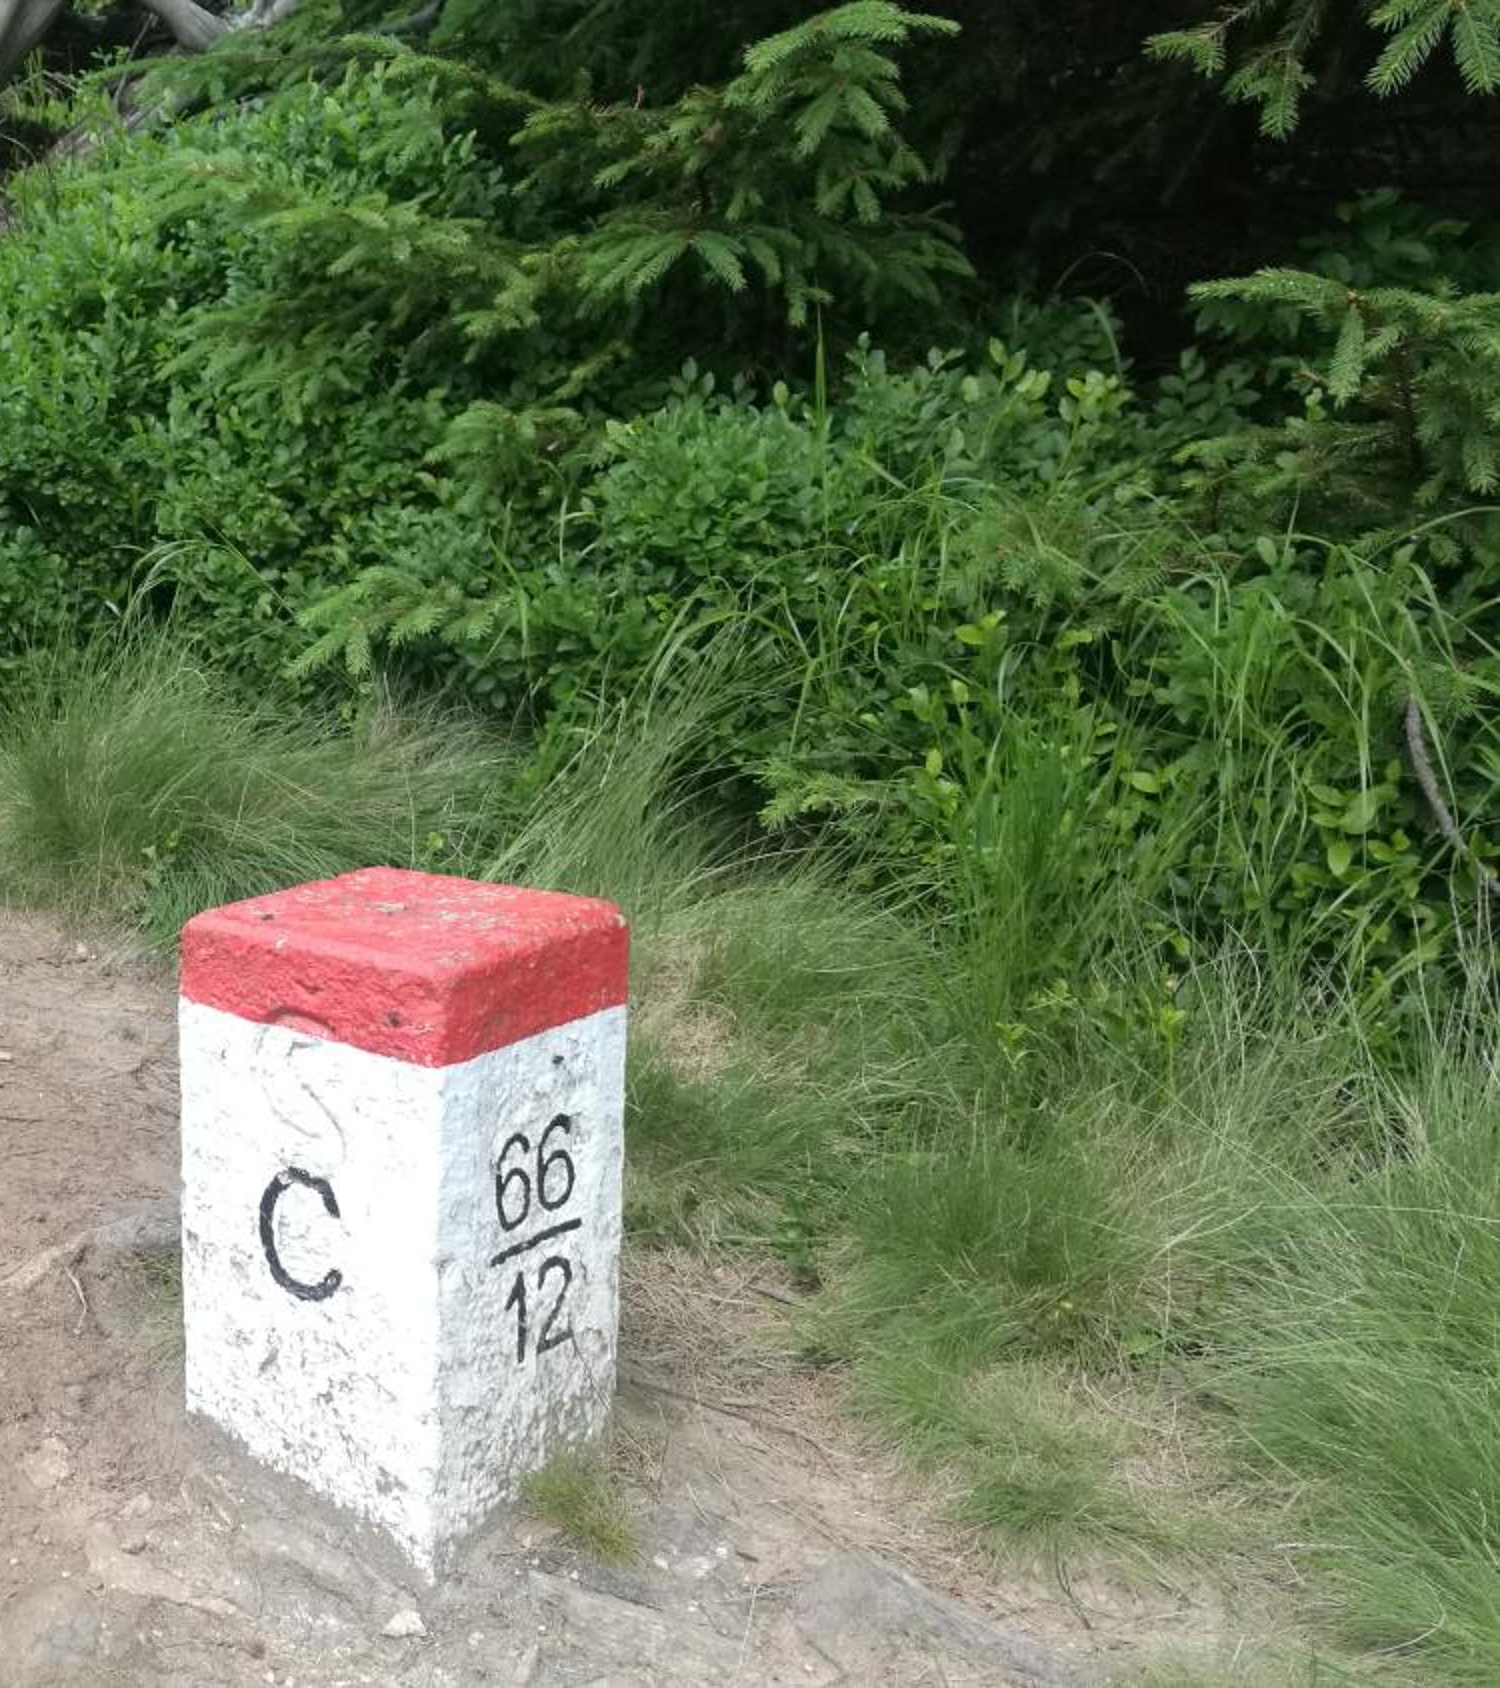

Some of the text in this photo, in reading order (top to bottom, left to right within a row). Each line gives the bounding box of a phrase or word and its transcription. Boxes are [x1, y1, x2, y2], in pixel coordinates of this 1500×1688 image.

[495, 1113, 575, 1231] 66
[259, 1166, 343, 1302] C
[505, 1256, 574, 1363] 12
